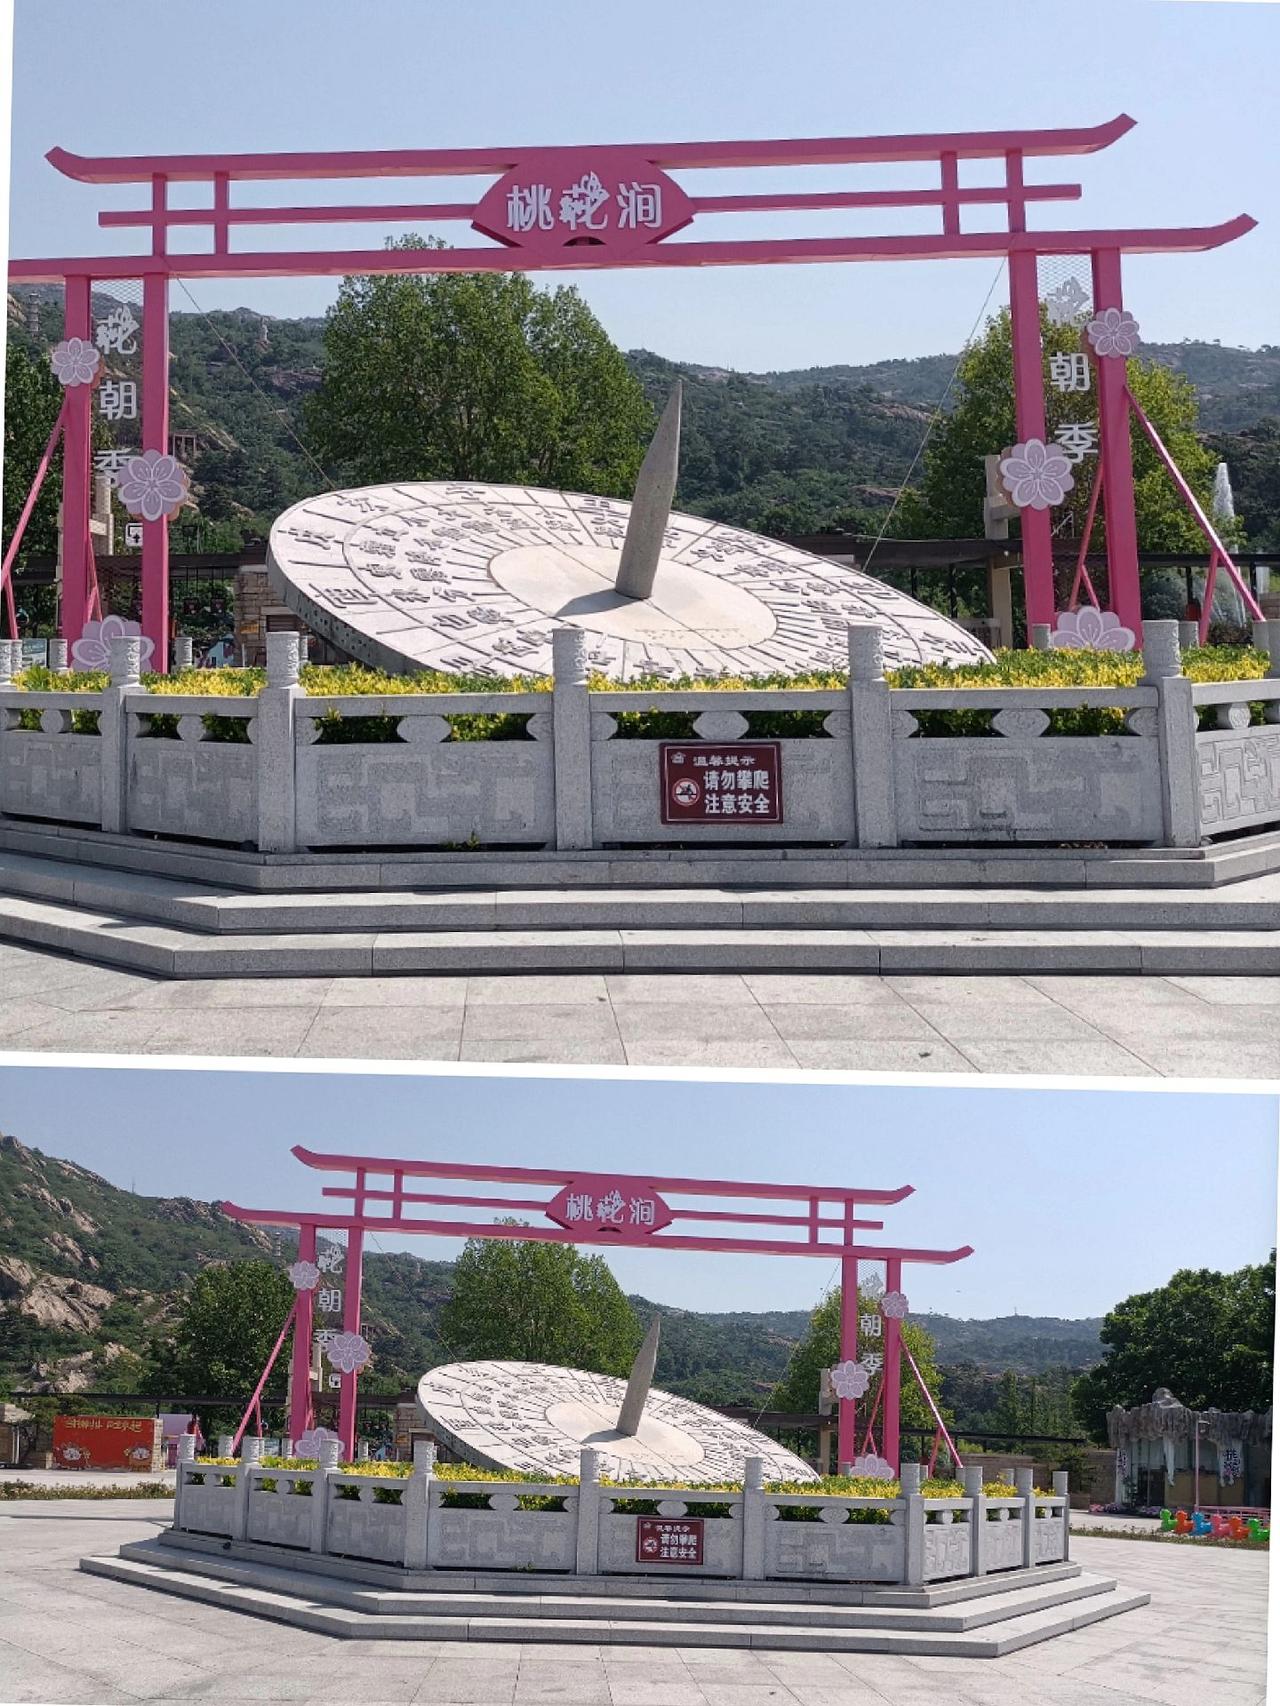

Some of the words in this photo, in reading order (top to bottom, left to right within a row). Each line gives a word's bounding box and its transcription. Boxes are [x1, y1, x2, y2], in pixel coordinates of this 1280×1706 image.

[506, 171, 662, 232] 桃花涧
[703, 769, 769, 791] 请勿攀爬
[704, 793, 770, 814] 注意安全
[566, 1190, 655, 1225] 桃花涧
